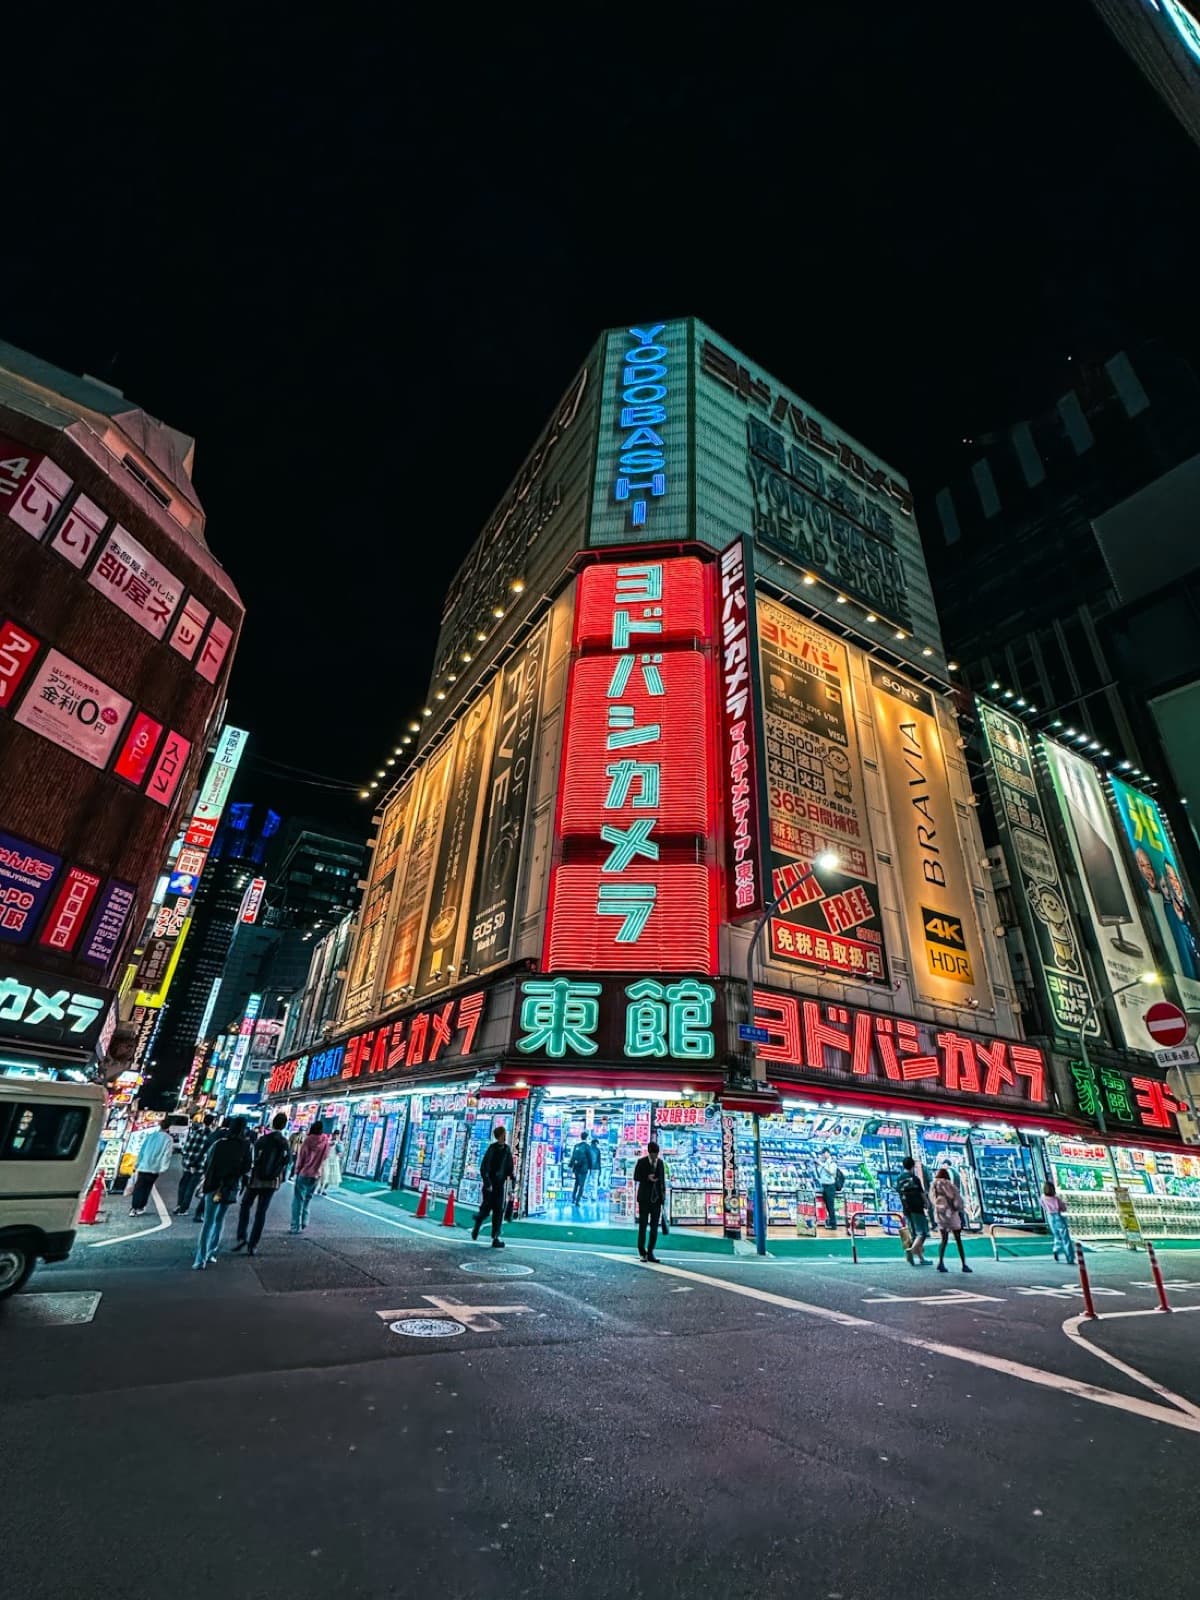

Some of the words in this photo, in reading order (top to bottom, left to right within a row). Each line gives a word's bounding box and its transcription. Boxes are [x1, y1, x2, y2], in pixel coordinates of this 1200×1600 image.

[615, 324, 668, 527] YODOBASHI
[721, 541, 749, 721] ヨドバシカメラ
[760, 620, 839, 673] ヨドバシ
[47, 673, 82, 701] アコムは
[776, 647, 827, 681] PREMIUM
[881, 674, 919, 704] SONY
[517, 641, 542, 750] POWER
[489, 659, 527, 819] FIVE
[597, 564, 666, 944] ヨドバシカメラ
[827, 728, 847, 744] VISA
[512, 755, 527, 797] OF
[729, 720, 755, 909] マルチメディア東館
[898, 721, 947, 889] BRAVIA
[1125, 793, 1163, 852] 光
[166, 897, 191, 937] ヨドバシ
[472, 917, 494, 942] EOS
[493, 911, 506, 931] 5D
[819, 884, 876, 936] FREE
[925, 915, 963, 943] 4K
[776, 926, 881, 973] 免税品取扱店
[929, 948, 970, 978] HDR
[0, 976, 105, 1034] カメラ
[1048, 974, 1089, 1000] ヨドバシ
[1056, 988, 1088, 1016] カメラ
[341, 990, 486, 1080] ヨドバシカメラ
[515, 977, 717, 1060] 東館
[752, 988, 1046, 1103] ヨドバシカメラ
[656, 1108, 697, 1124] 双眼鏡
[1131, 1076, 1188, 1128] ヨド
